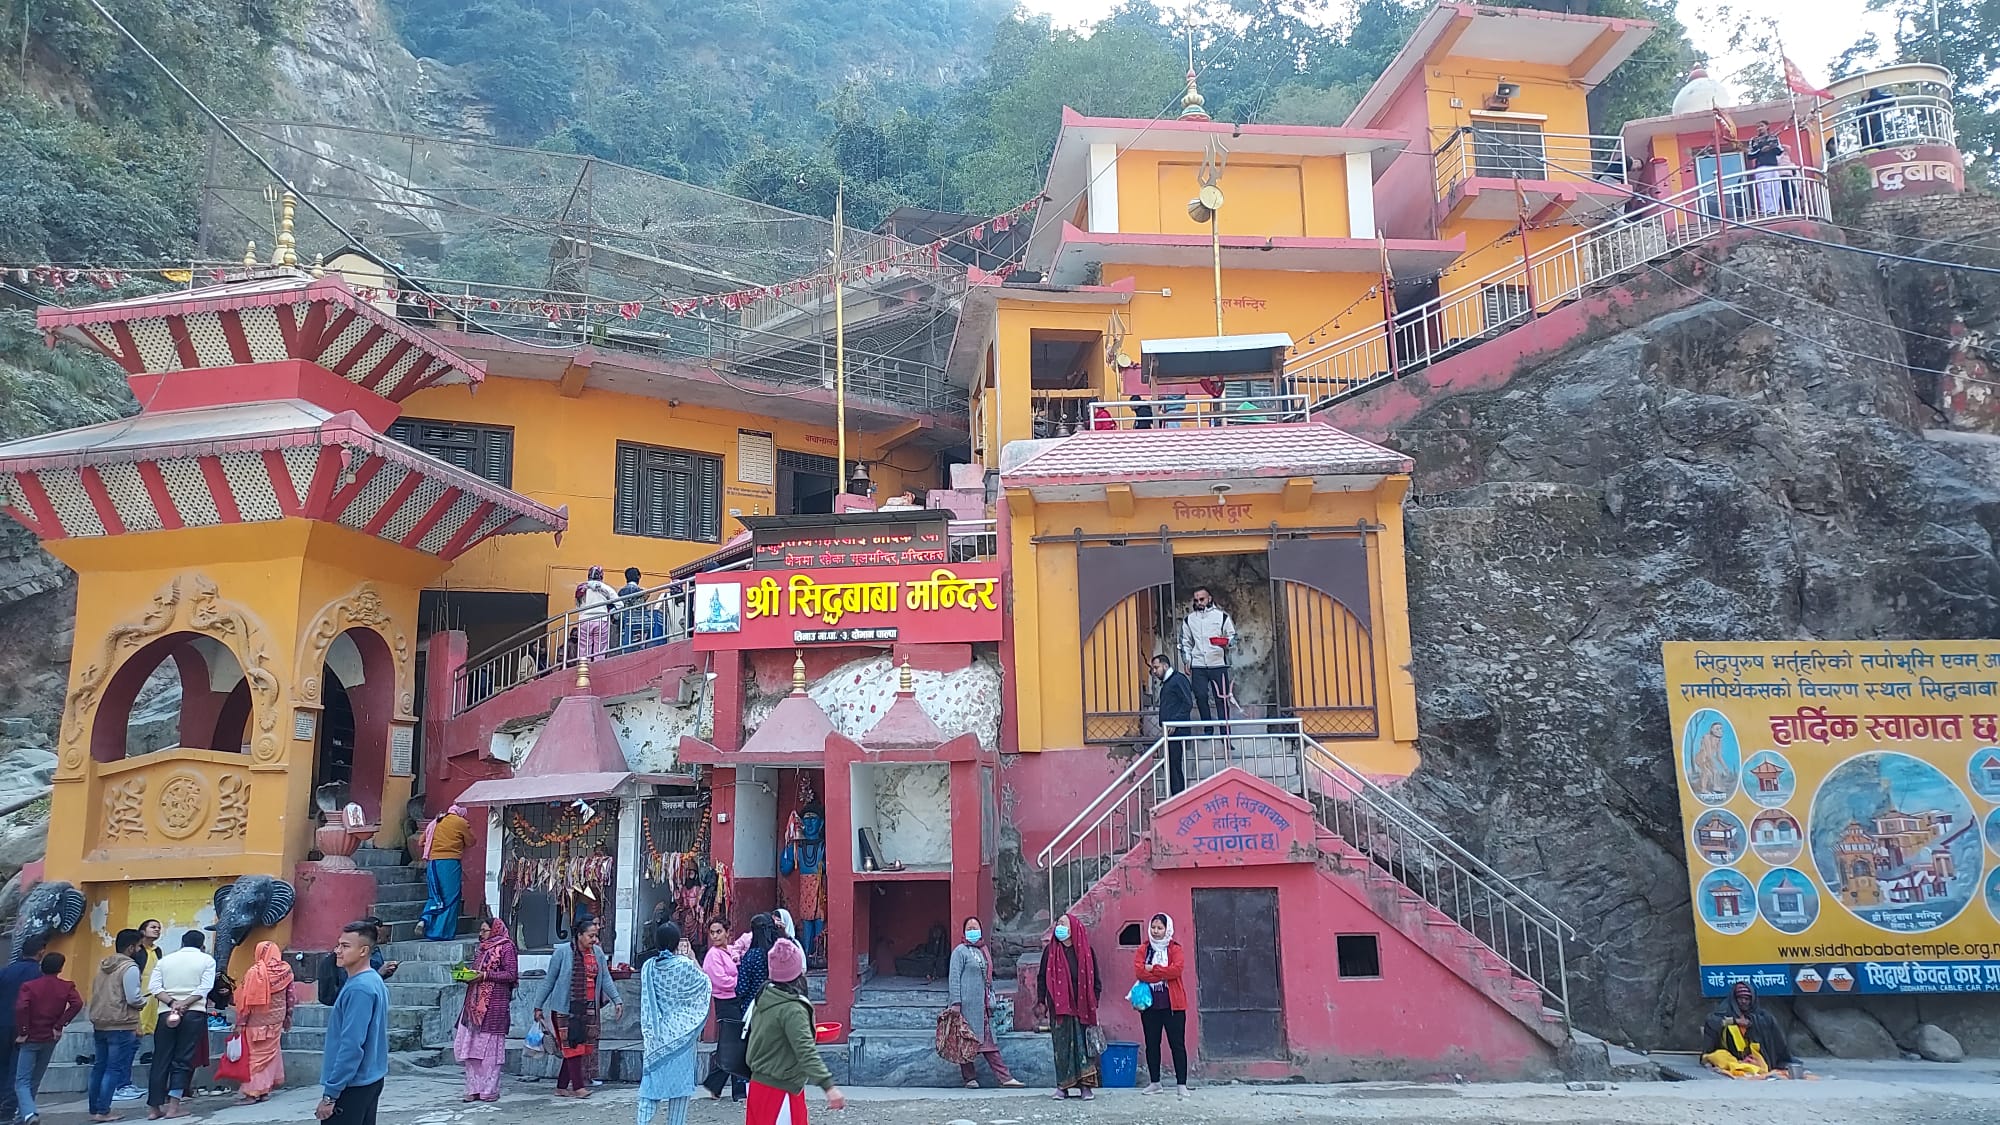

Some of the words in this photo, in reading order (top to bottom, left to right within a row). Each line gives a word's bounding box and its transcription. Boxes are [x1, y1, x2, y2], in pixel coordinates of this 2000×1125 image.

[1173, 501, 1224, 521] निकास
[1227, 503, 1253, 523] द्वार
[745, 576, 782, 619] श्री
[905, 569, 1000, 612] मन्दिर
[1859, 648, 1934, 675] तपोभूमि
[1797, 678, 1859, 702] विचरण
[1864, 681, 1913, 701] स्थल
[1769, 706, 1859, 747] हार्दिक
[1863, 714, 1964, 743] स्वागत
[1212, 812, 1251, 832] हार्दिक
[1192, 833, 1259, 852] स्वागत
[1911, 961, 1951, 985] केवल
[1951, 965, 1983, 985] कार
[1965, 984, 1981, 992] CAR
